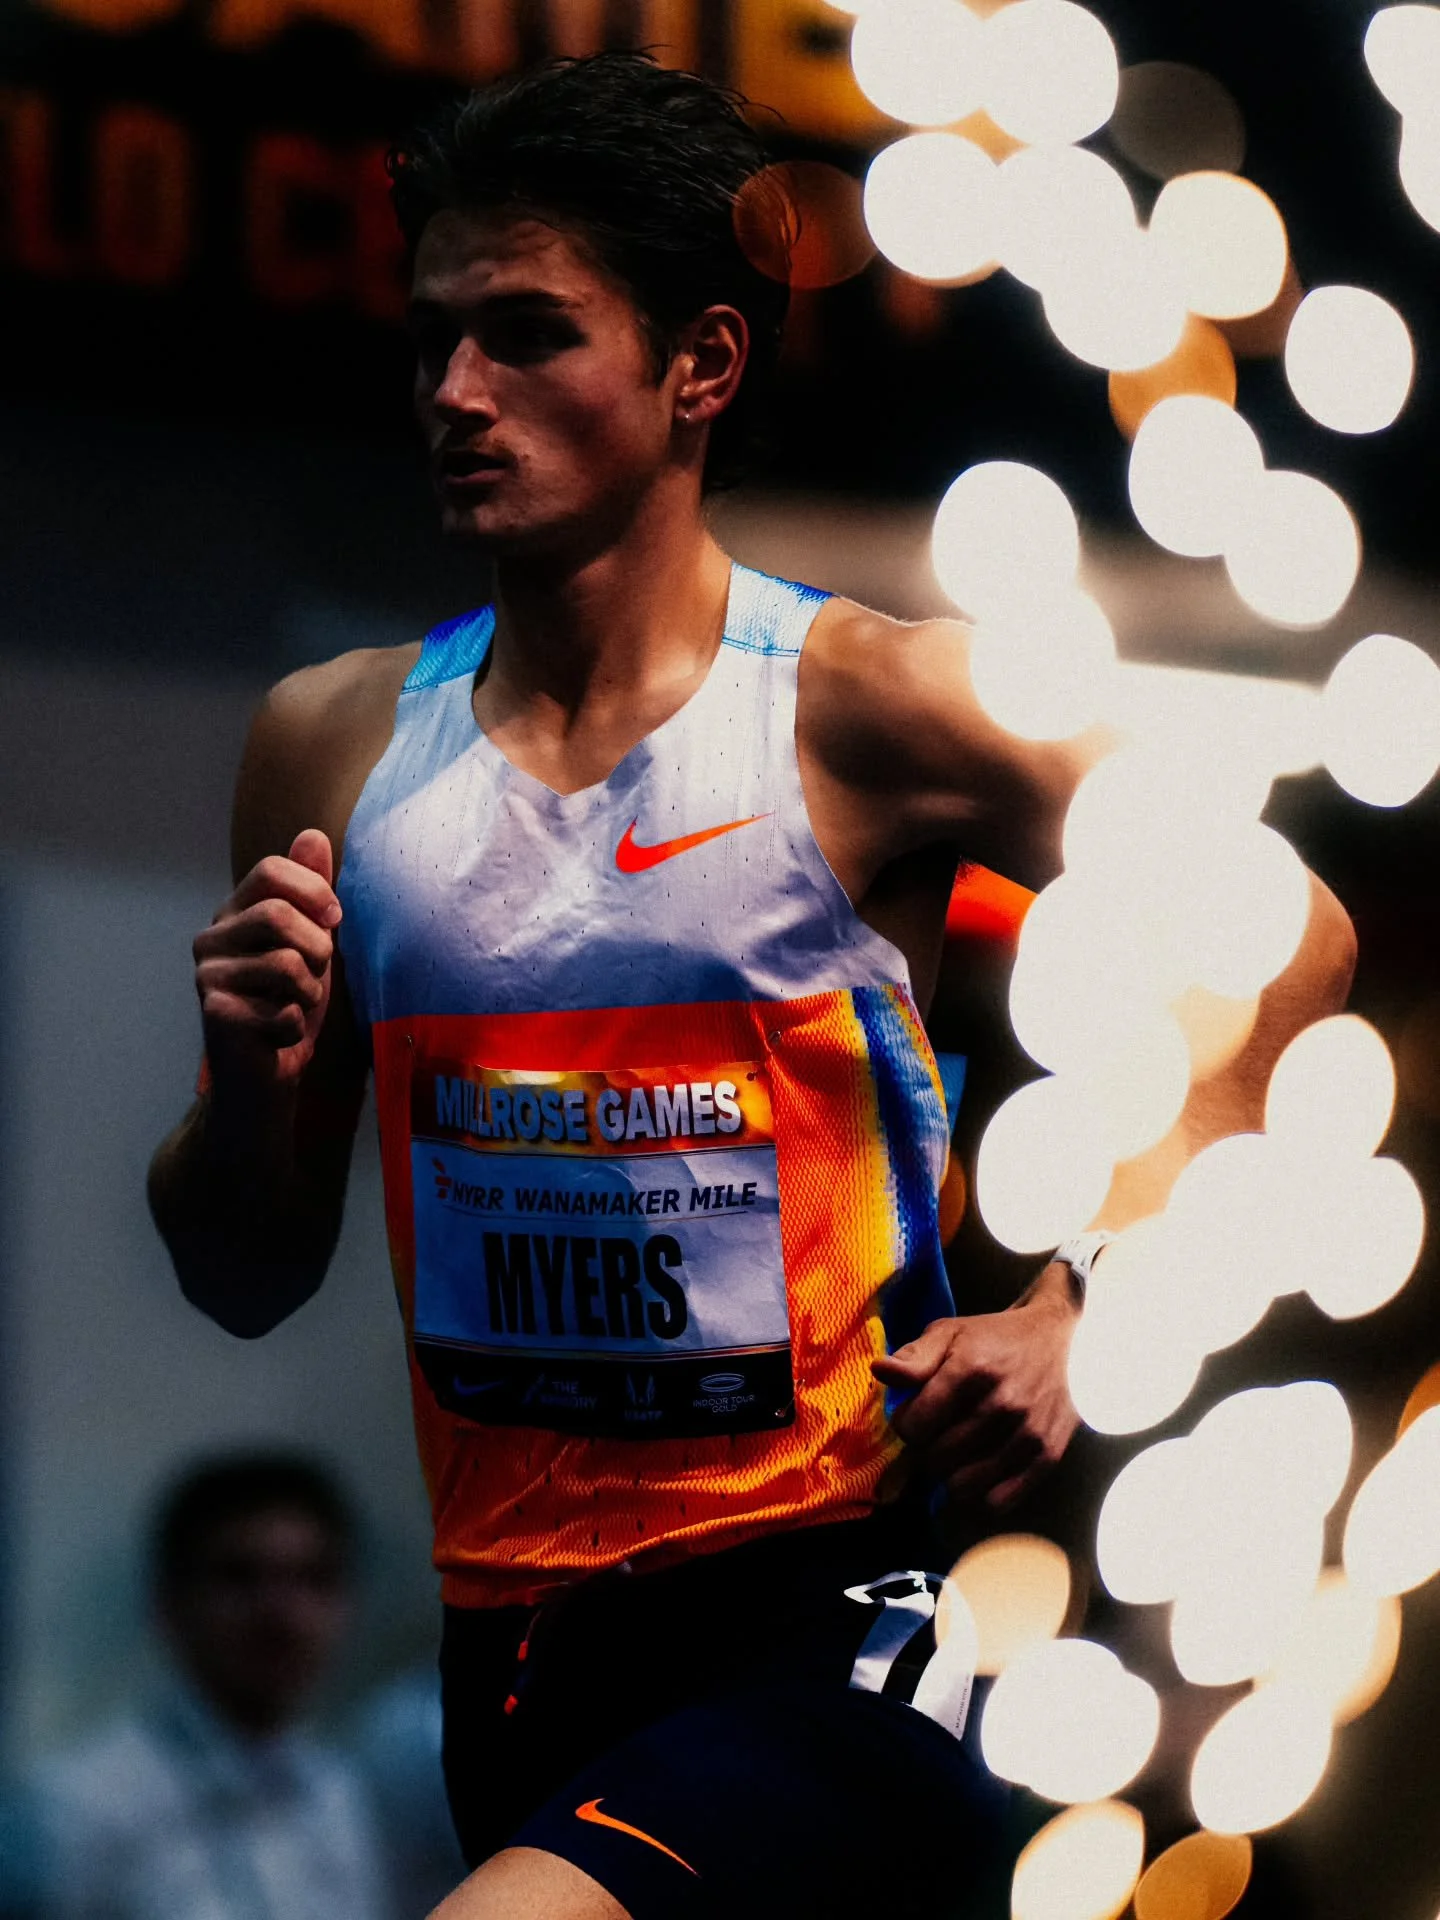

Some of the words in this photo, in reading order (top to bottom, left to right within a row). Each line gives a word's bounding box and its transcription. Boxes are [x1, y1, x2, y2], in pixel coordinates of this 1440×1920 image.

[434, 1074, 588, 1142] MILLROSE
[597, 1080, 741, 1142] GAMES
[453, 1185, 504, 1210] NYRR
[515, 1189, 680, 1216] WANAMAKER
[689, 1183, 757, 1211] MILE
[484, 1233, 688, 1340] MYERS
